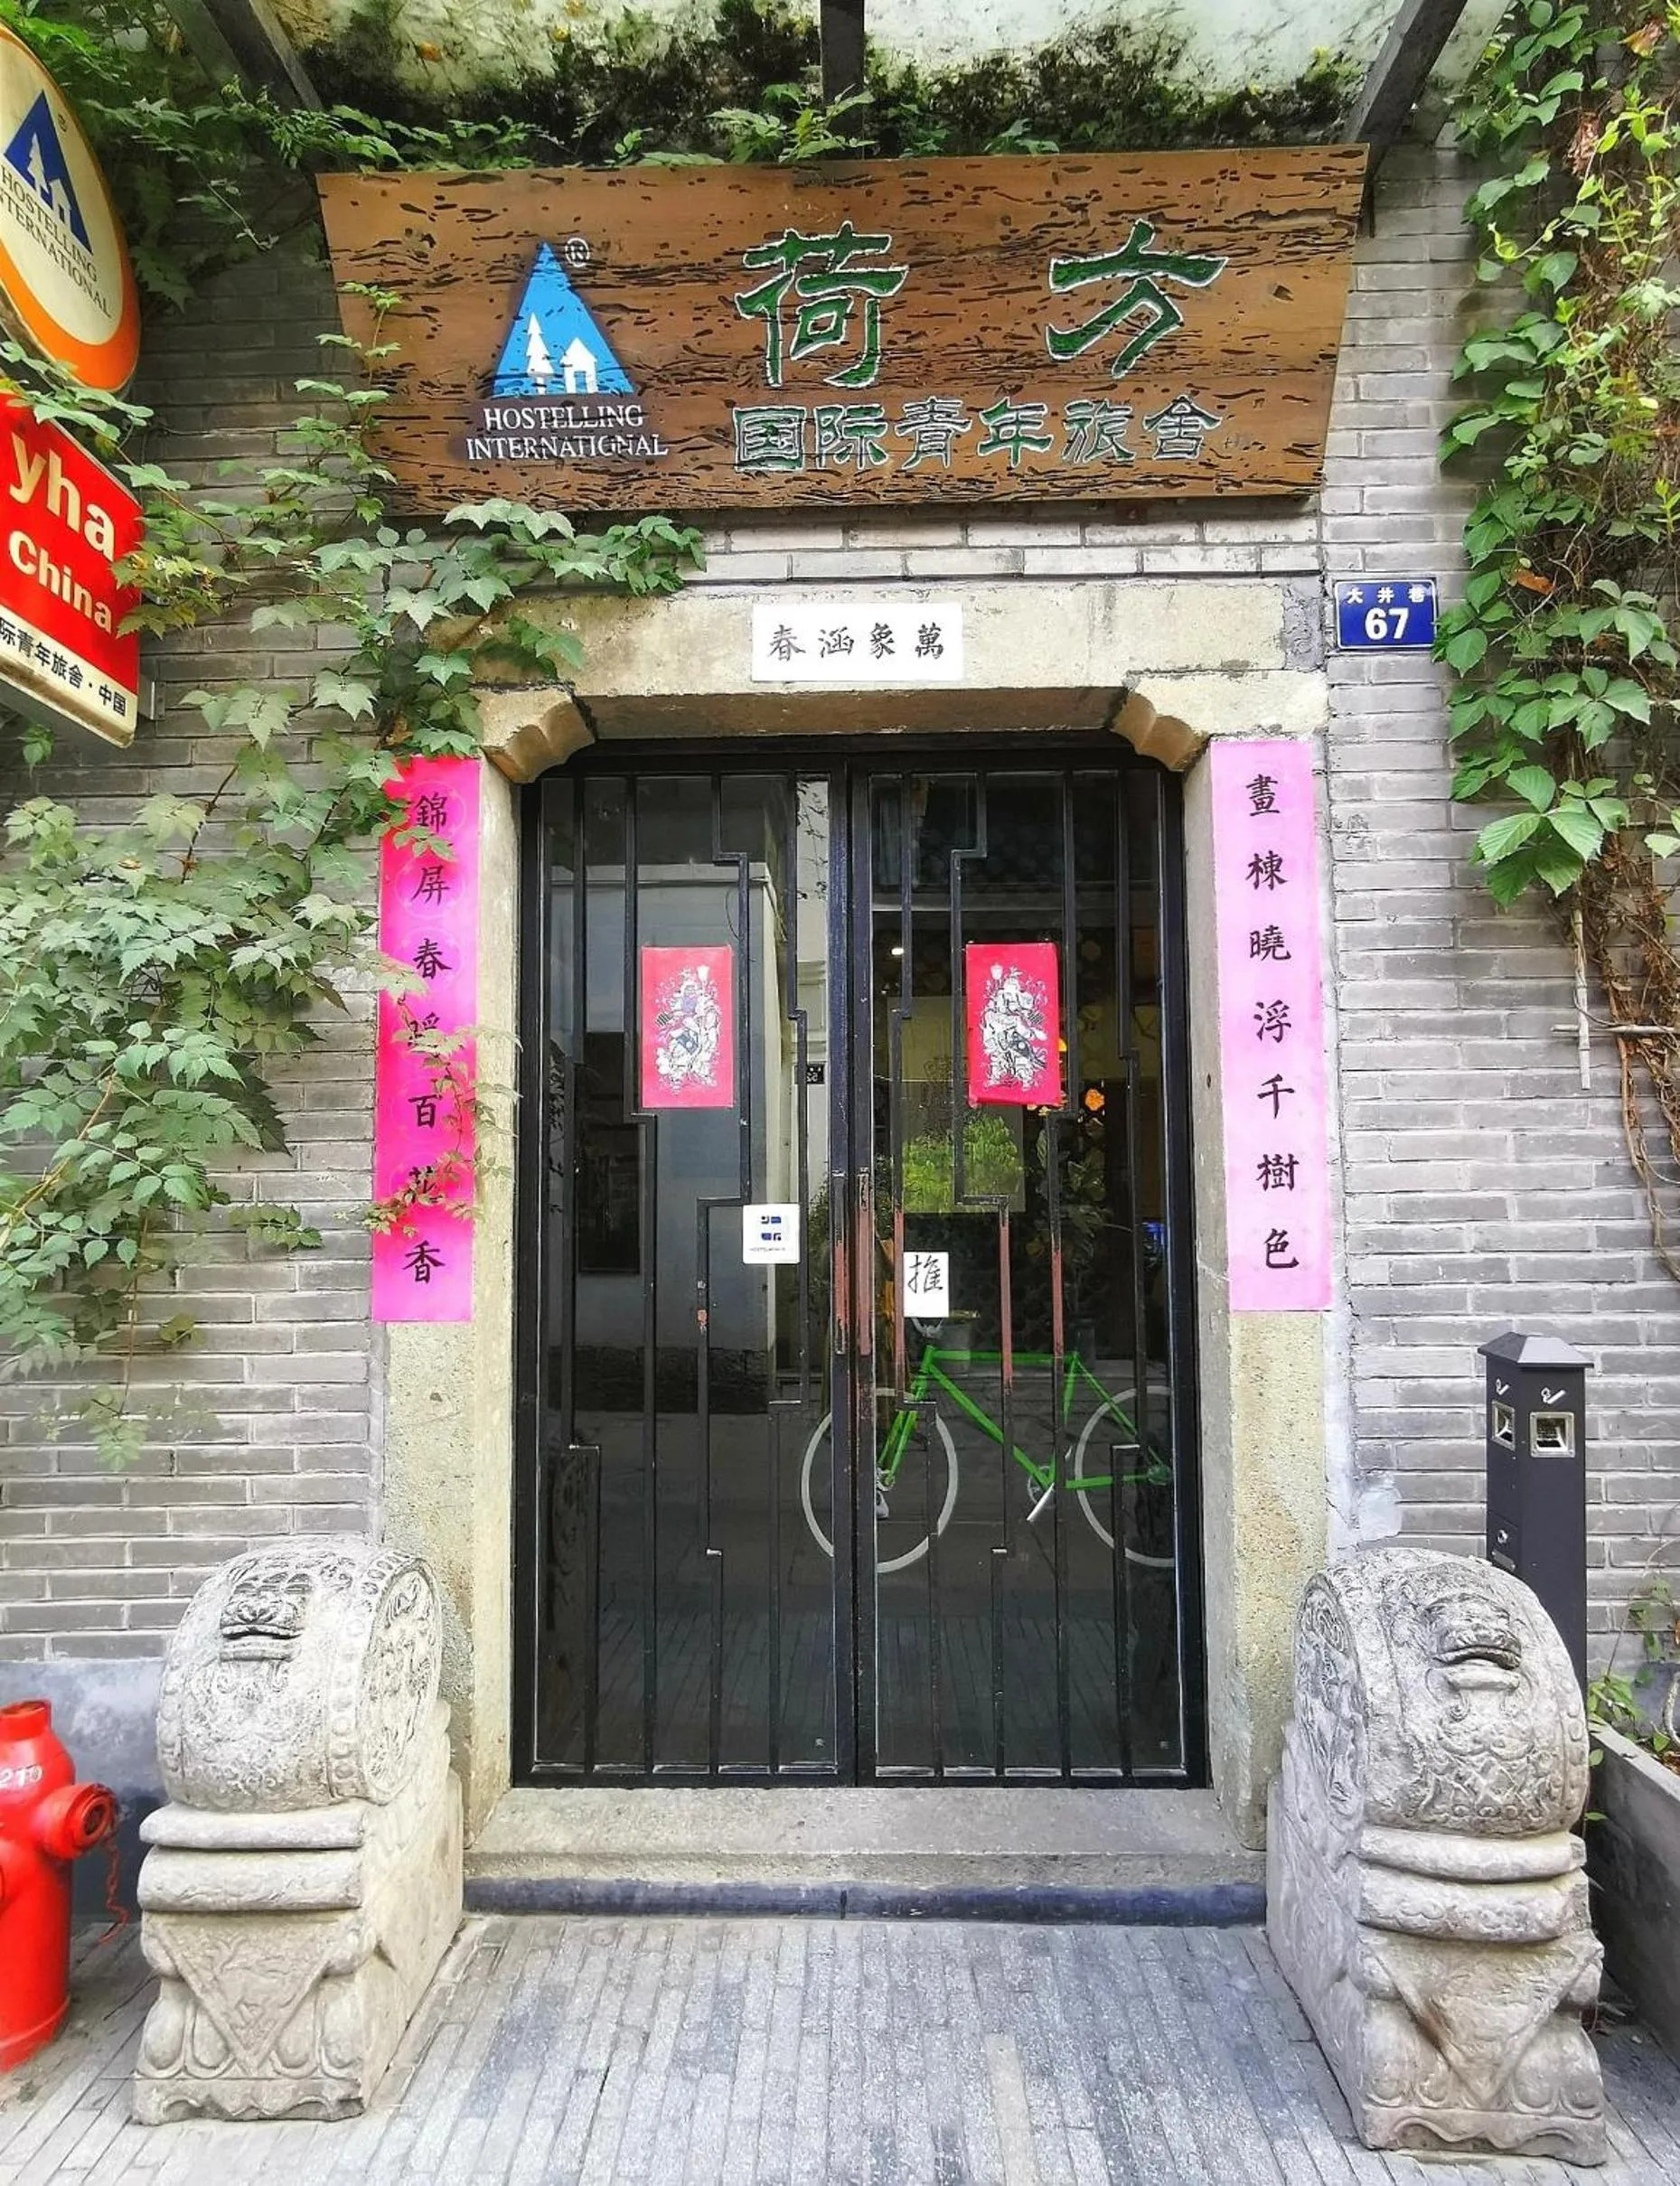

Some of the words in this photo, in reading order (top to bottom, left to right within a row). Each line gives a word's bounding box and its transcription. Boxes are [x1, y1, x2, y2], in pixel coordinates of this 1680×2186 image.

[1, 164, 98, 282] HOSTELLING
[735, 219, 1229, 389] 荷方
[483, 404, 643, 431] HOSTELLING
[465, 433, 670, 460] INTERNATIONAL
[10, 432, 115, 562] yha
[9, 530, 112, 635] China
[1347, 586, 1426, 604] 大井巷
[1365, 607, 1409, 640] 67
[907, 1254, 943, 1294] 推
